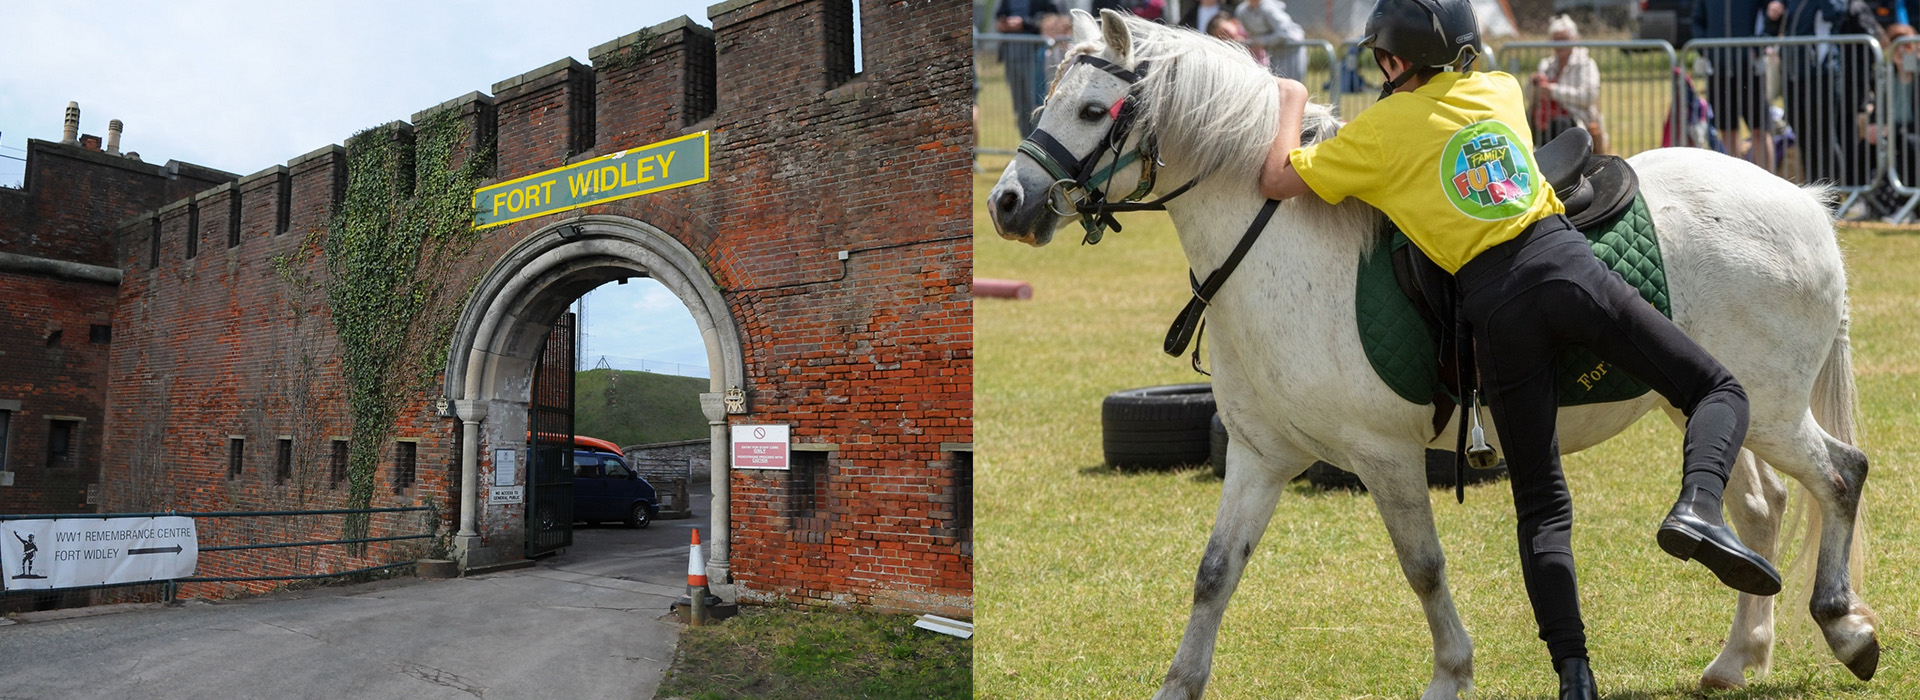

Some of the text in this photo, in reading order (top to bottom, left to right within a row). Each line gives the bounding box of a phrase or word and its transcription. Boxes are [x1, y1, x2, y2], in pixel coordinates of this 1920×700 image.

[493, 151, 676, 216] FORT WIDLEY
[1452, 159, 1507, 200] FUN
[1486, 172, 1531, 205] DAY
[1577, 361, 1608, 391] For
[56, 527, 191, 542] WW1 REMEMBRANCE CENTRE
[54, 548, 120, 561] FORT WIDLEY
